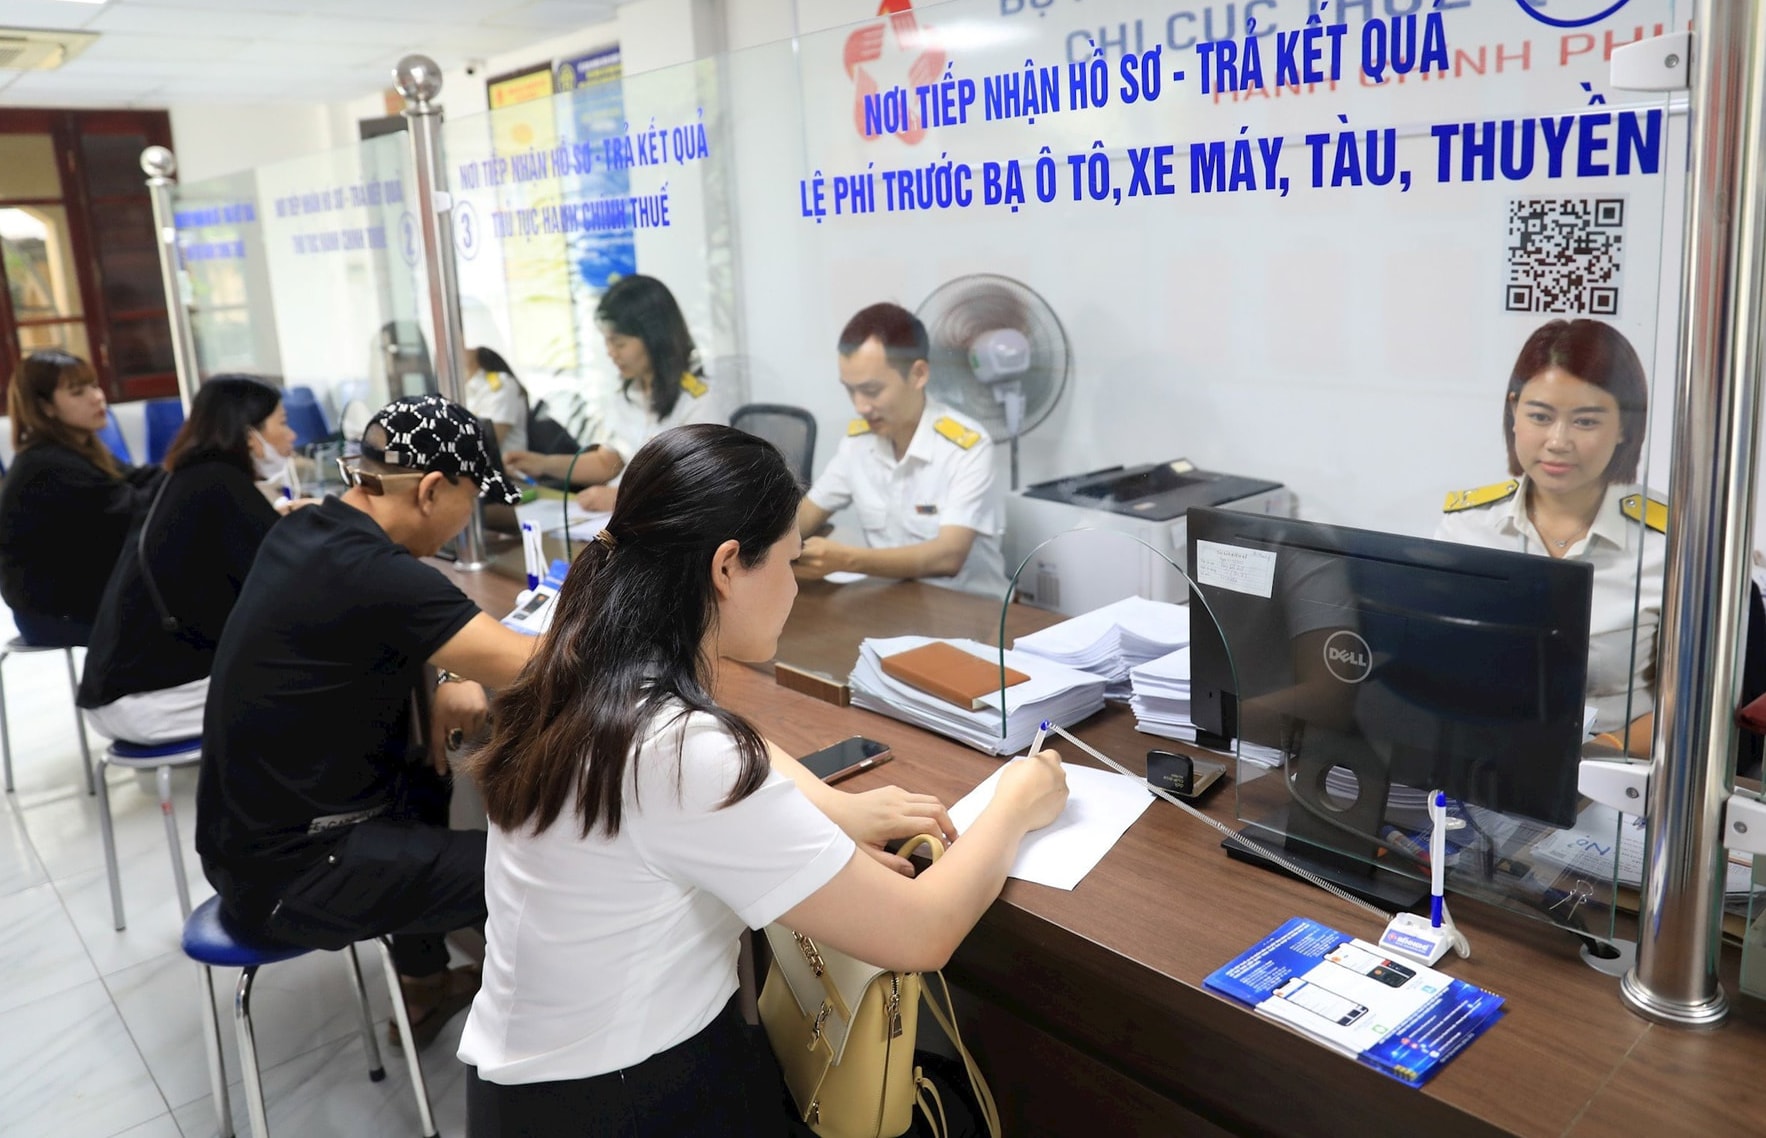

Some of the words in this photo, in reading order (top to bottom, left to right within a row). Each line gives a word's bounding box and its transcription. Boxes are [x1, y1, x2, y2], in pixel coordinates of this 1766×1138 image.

[865, 87, 908, 135] NƠI
[916, 61, 976, 128] TIẾP
[984, 60, 1060, 125] NHẬN
[1069, 40, 1109, 111] HỒ
[1120, 45, 1162, 105] SƠ
[1196, 17, 1263, 95] TRẢ
[1277, 1, 1348, 86] KẾT
[603, 121, 636, 171] TRẢ
[637, 116, 668, 166] KẾT
[672, 106, 709, 166] QUẢ
[801, 170, 827, 224] LỆ
[834, 163, 875, 215] PHÍ
[882, 152, 972, 212] TRƯỚC
[984, 160, 1025, 213] BẠ
[1036, 146, 1056, 203] Ô
[1191, 127, 1289, 198] MÁY,
[1306, 115, 1411, 192] TÀU,
[1432, 82, 1662, 183] THUYỀN
[461, 212, 473, 249] 3
[629, 181, 671, 229] THUẾ
[1328, 647, 1367, 667] DELL
